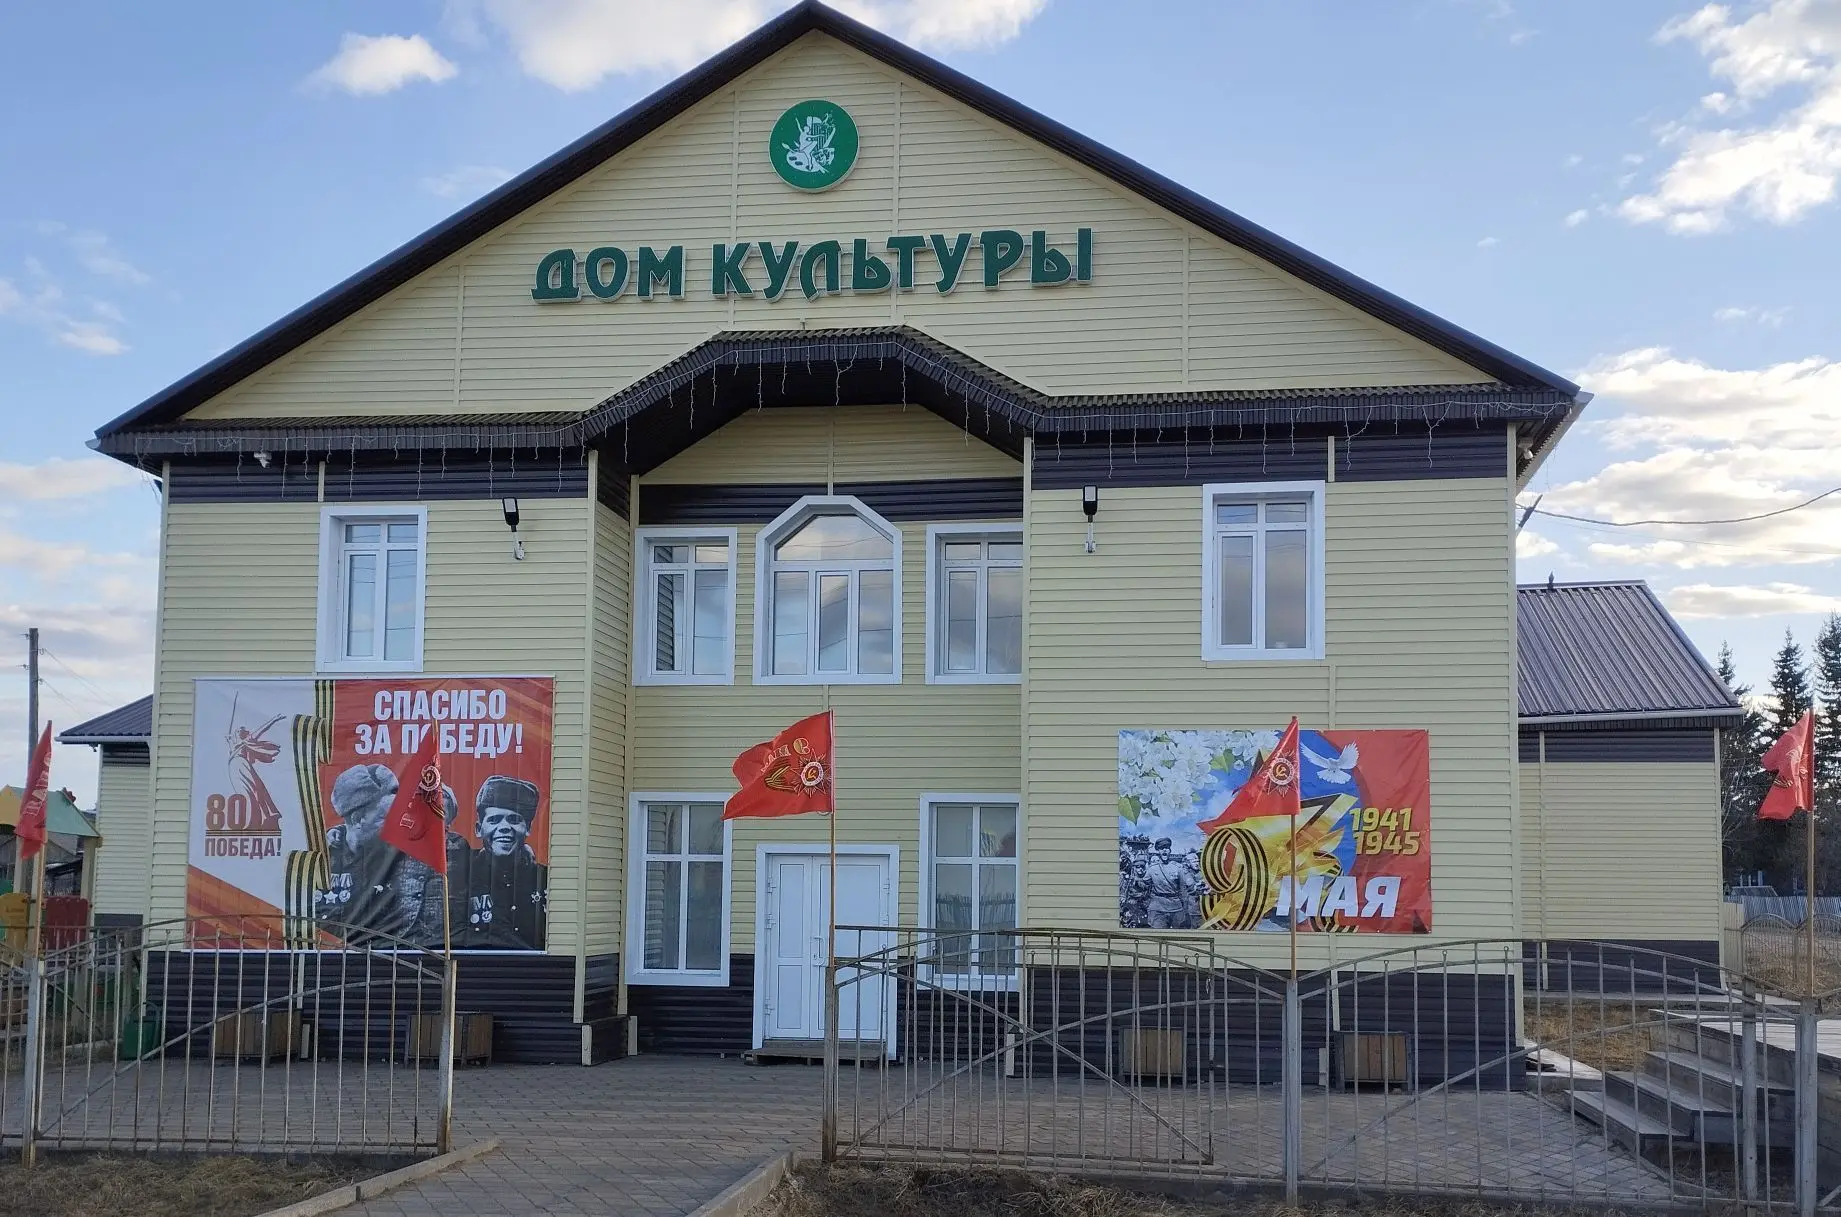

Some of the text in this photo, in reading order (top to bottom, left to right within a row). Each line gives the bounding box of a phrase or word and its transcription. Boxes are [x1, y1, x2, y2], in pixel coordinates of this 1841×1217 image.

[530, 228, 1093, 304] ДОМ КУЛЬТУРЫ
[374, 689, 507, 721] СПАСИБО
[354, 724, 523, 759] ЗА ПБЕДУ!
[206, 793, 247, 831] 80
[1349, 807, 1412, 832] 1941
[204, 835, 282, 860] ПОБЕДА!
[1353, 831, 1420, 856] 1945
[1275, 875, 1402, 918] МАЯ
